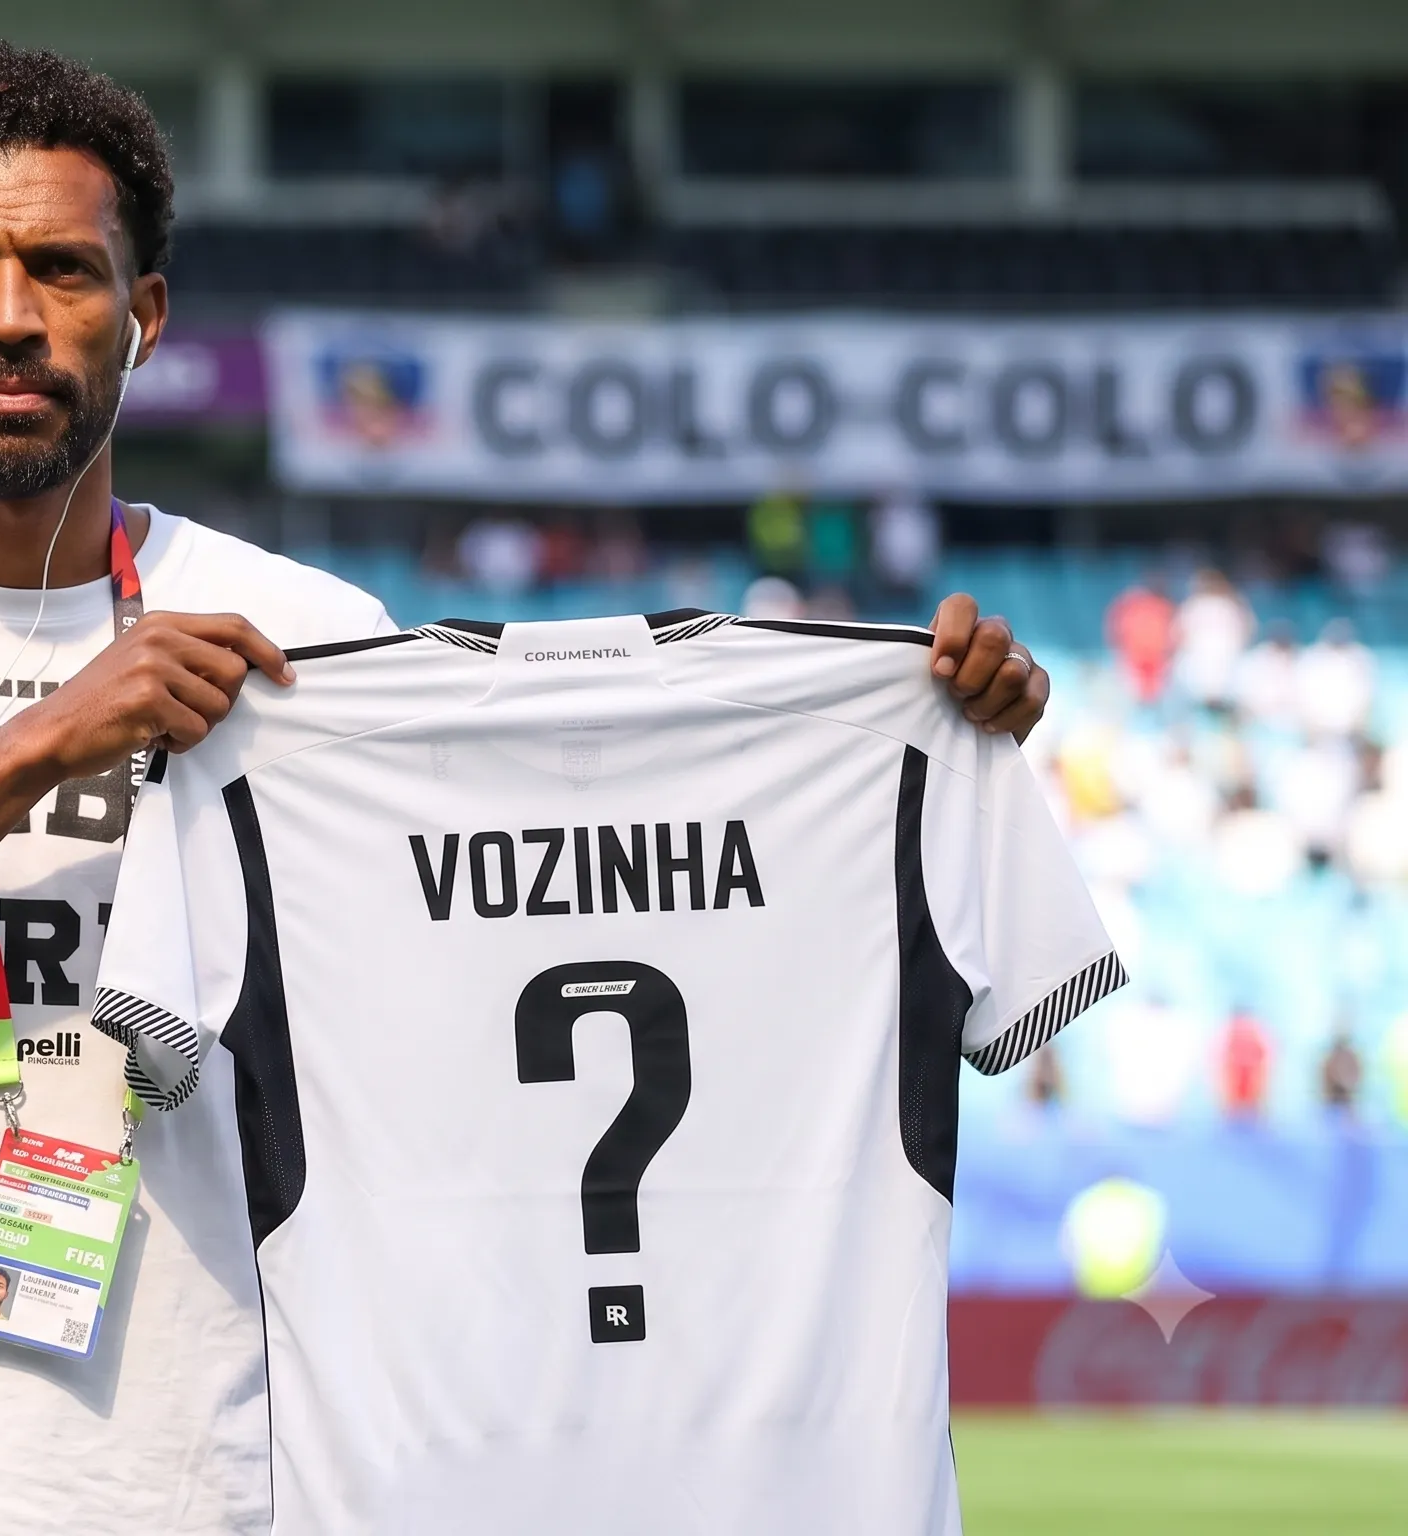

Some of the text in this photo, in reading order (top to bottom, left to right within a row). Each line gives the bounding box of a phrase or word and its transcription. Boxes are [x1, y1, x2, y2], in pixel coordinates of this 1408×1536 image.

[472, 348, 1260, 462] COLO COLO
[524, 647, 632, 663] CORUMENTAL
[407, 819, 766, 922] VOZINHA
[64, 1246, 106, 1271] FIFA
